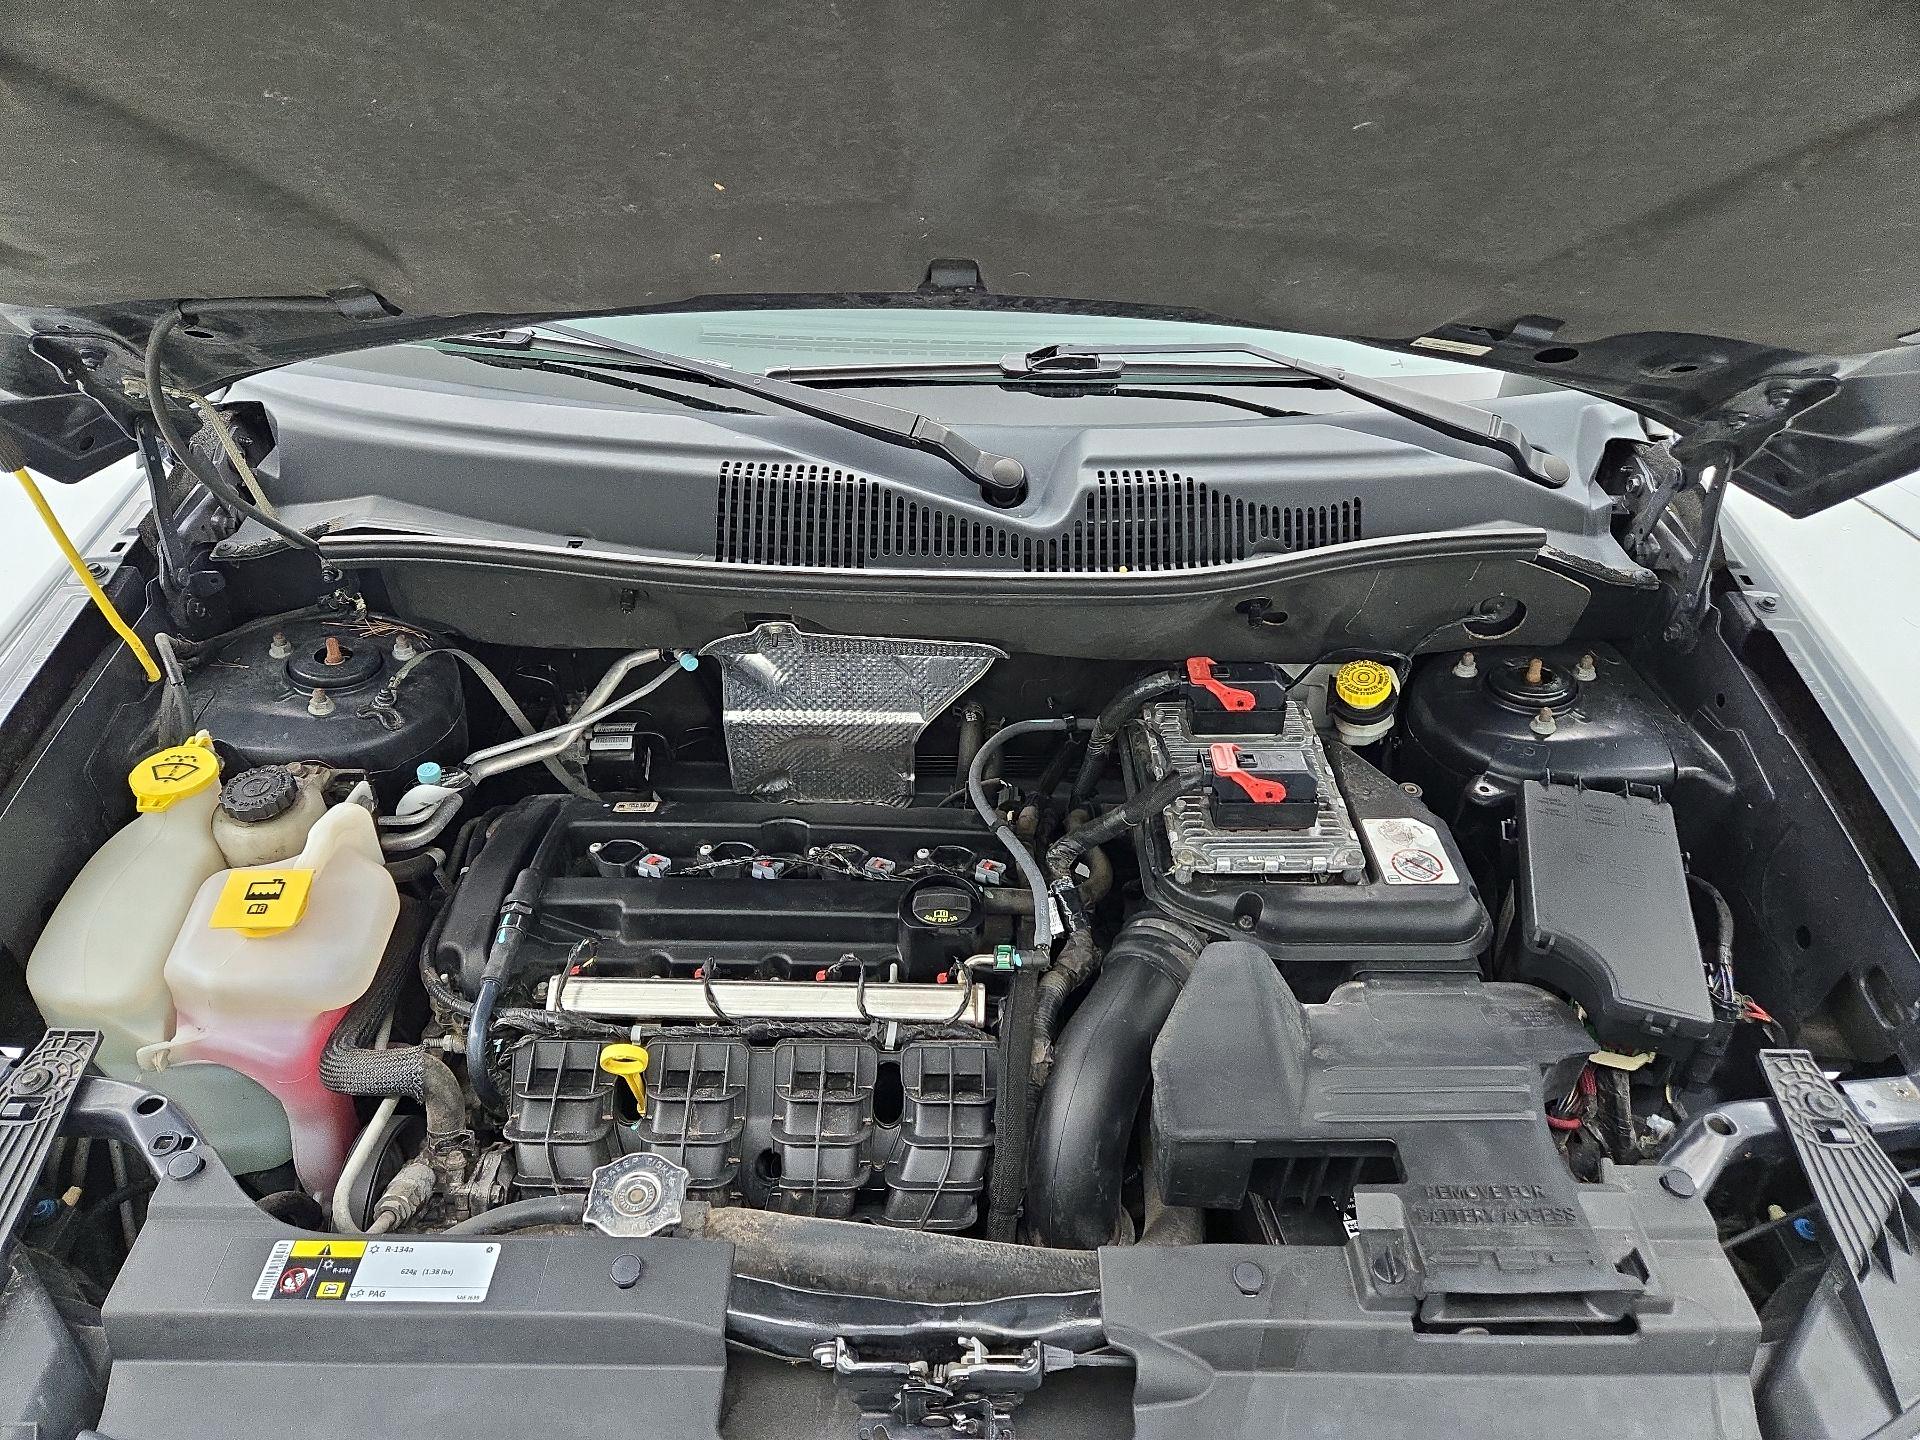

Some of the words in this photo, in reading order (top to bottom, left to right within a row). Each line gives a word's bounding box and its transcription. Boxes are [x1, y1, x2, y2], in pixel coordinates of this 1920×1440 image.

[1424, 1184, 1502, 1200] REMOVE
[1507, 1184, 1548, 1200] FOR
[1421, 1208, 1495, 1224] BATTERY
[1502, 1207, 1577, 1223] ACCESS
[385, 1244, 414, 1254] R-134a
[400, 1268, 418, 1277] 624g
[368, 1290, 386, 1299] PAG
